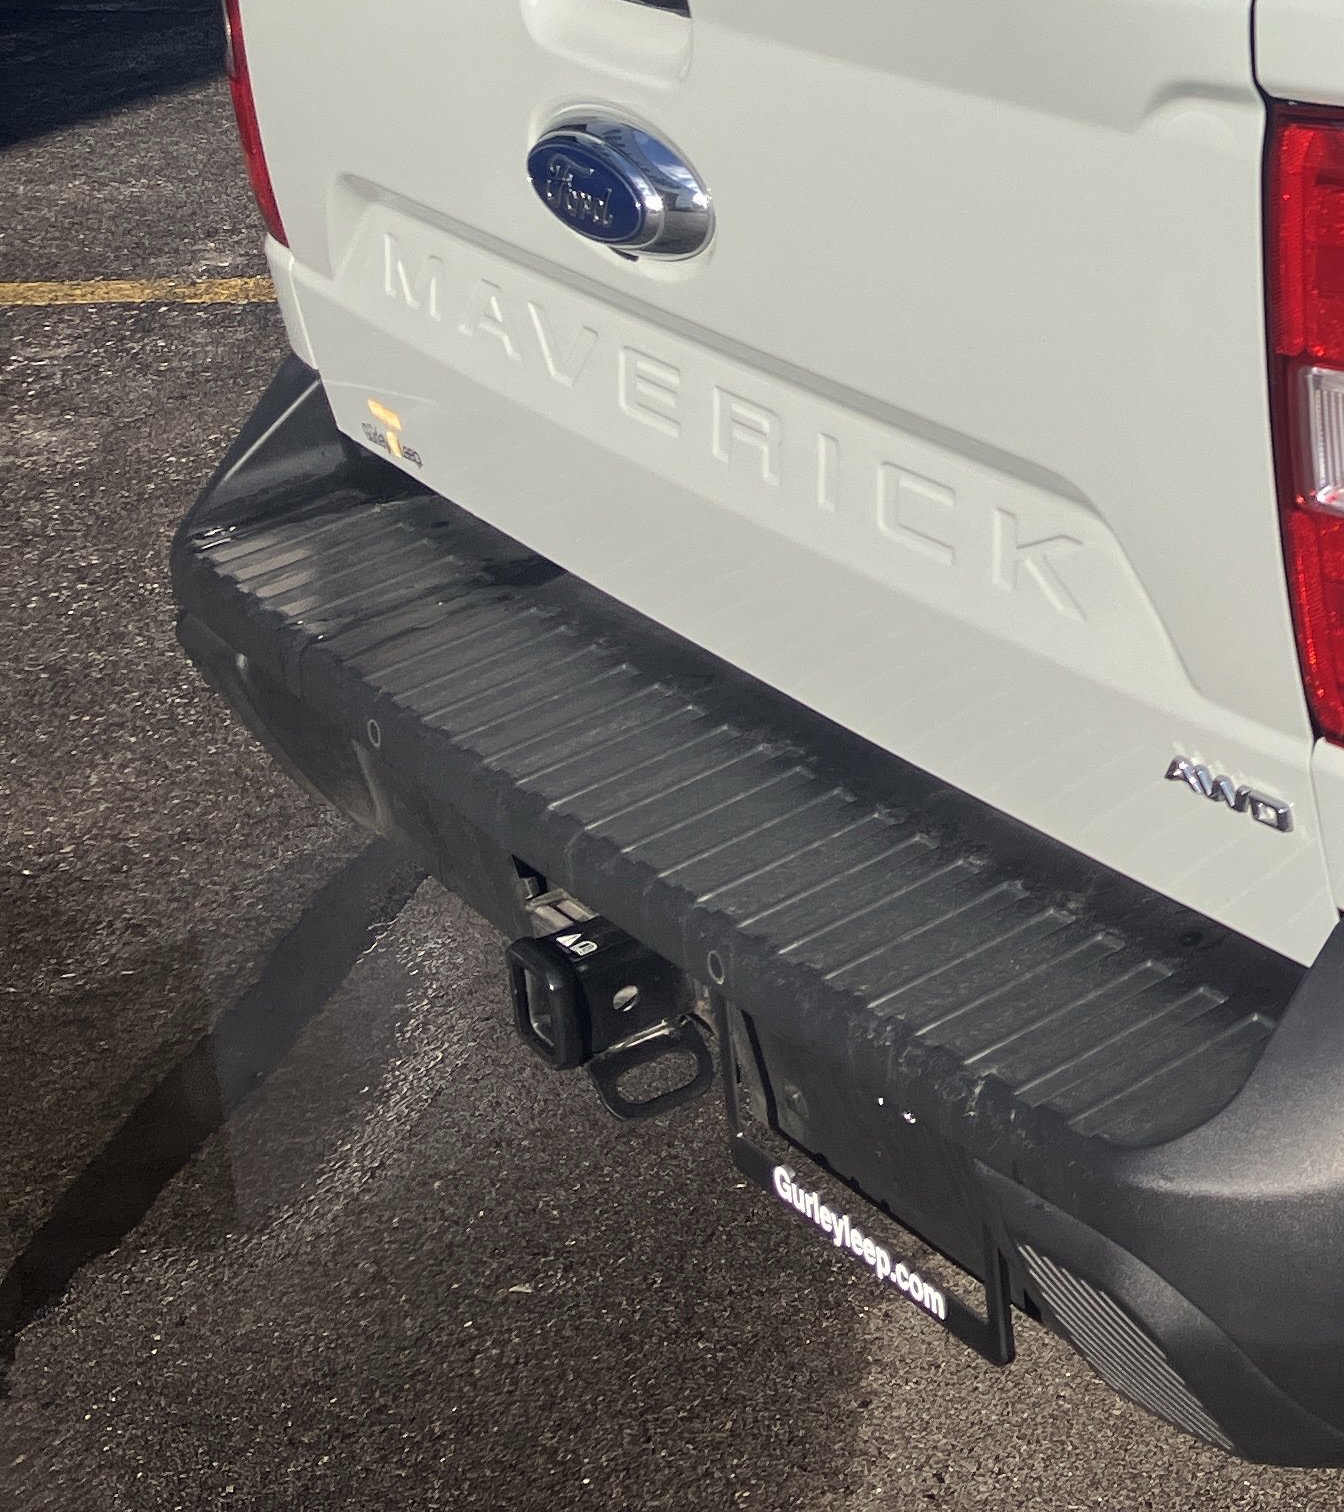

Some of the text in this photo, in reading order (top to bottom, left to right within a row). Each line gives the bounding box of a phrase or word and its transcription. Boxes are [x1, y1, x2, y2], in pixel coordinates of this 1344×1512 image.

[547, 153, 615, 229] Ford
[382, 231, 1087, 624] MAVERICK
[1164, 754, 1294, 833] AWD
